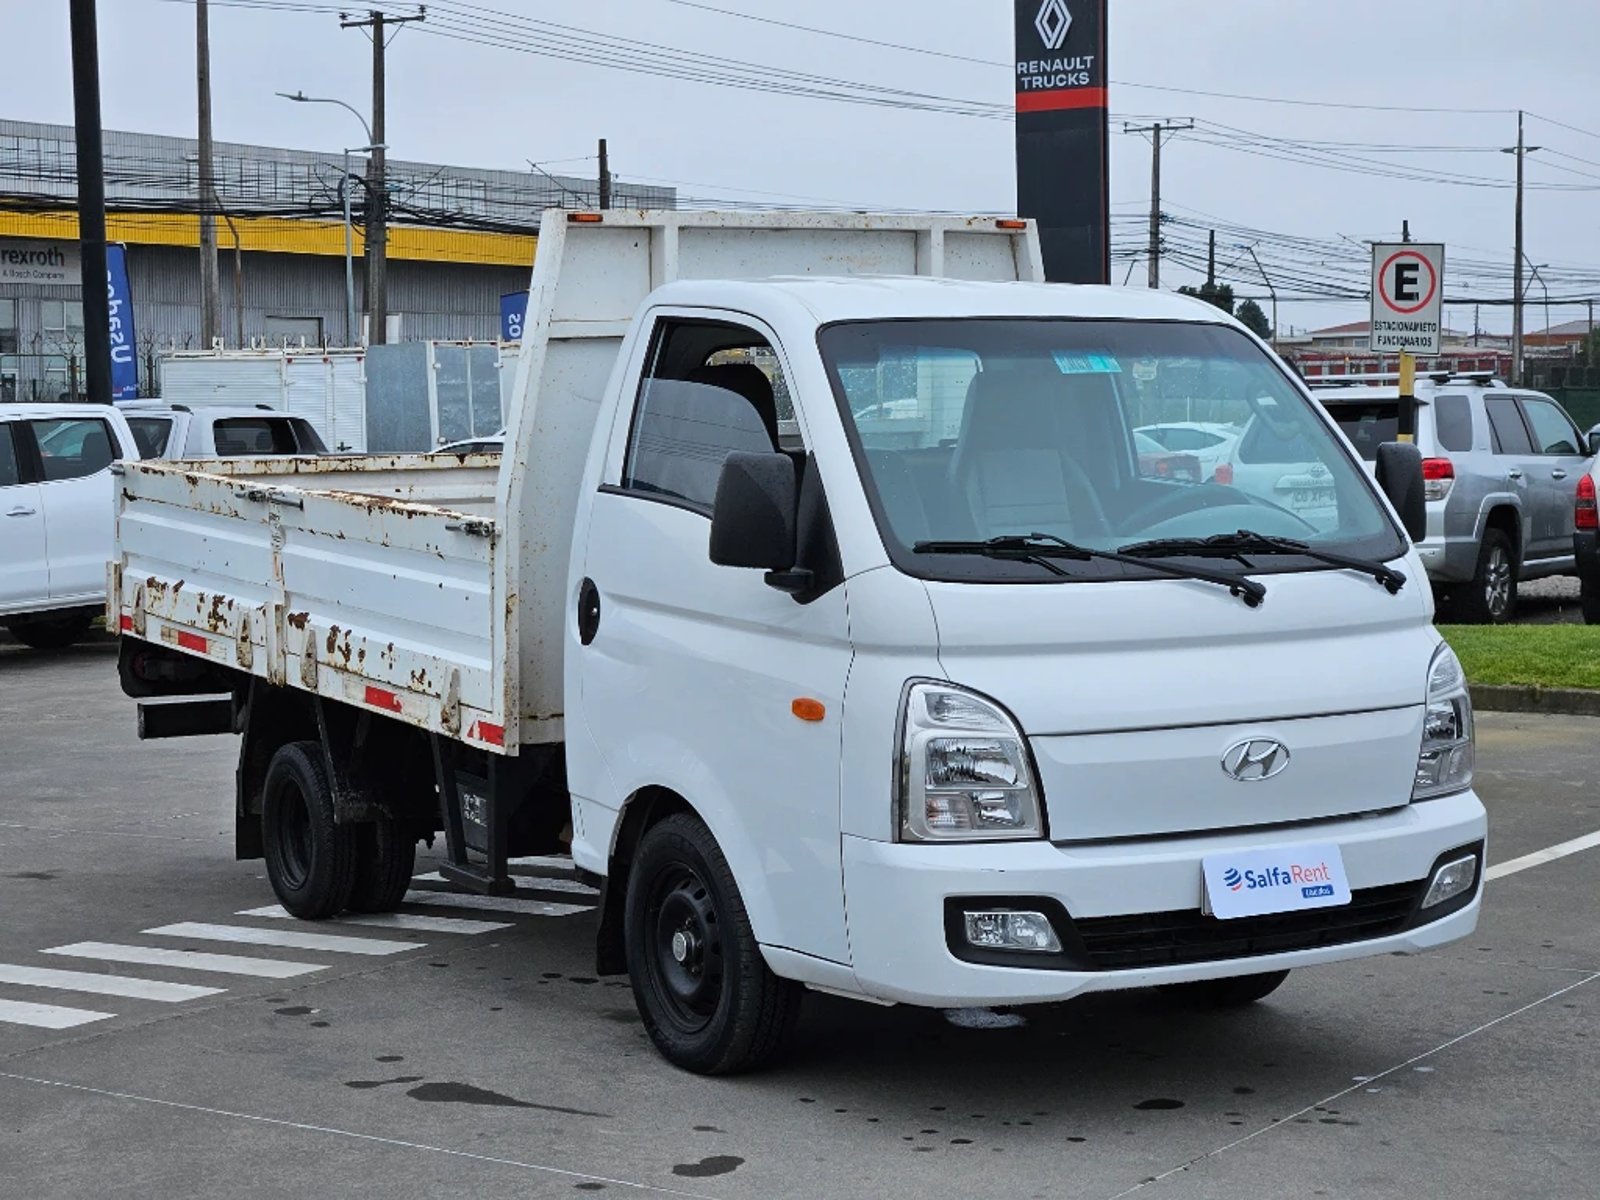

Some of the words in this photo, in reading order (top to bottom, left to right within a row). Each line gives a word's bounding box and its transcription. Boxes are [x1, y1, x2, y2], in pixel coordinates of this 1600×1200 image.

[1016, 55, 1094, 74] RENAULT
[1021, 71, 1090, 90] TRUCKS
[1, 246, 65, 266] rexroth
[9, 268, 31, 278] Bosch
[32, 269, 65, 280] Company
[1394, 263, 1420, 301] E
[1377, 335, 1432, 347] FUNCIONARIOS
[1244, 862, 1331, 889] SalfaRent
